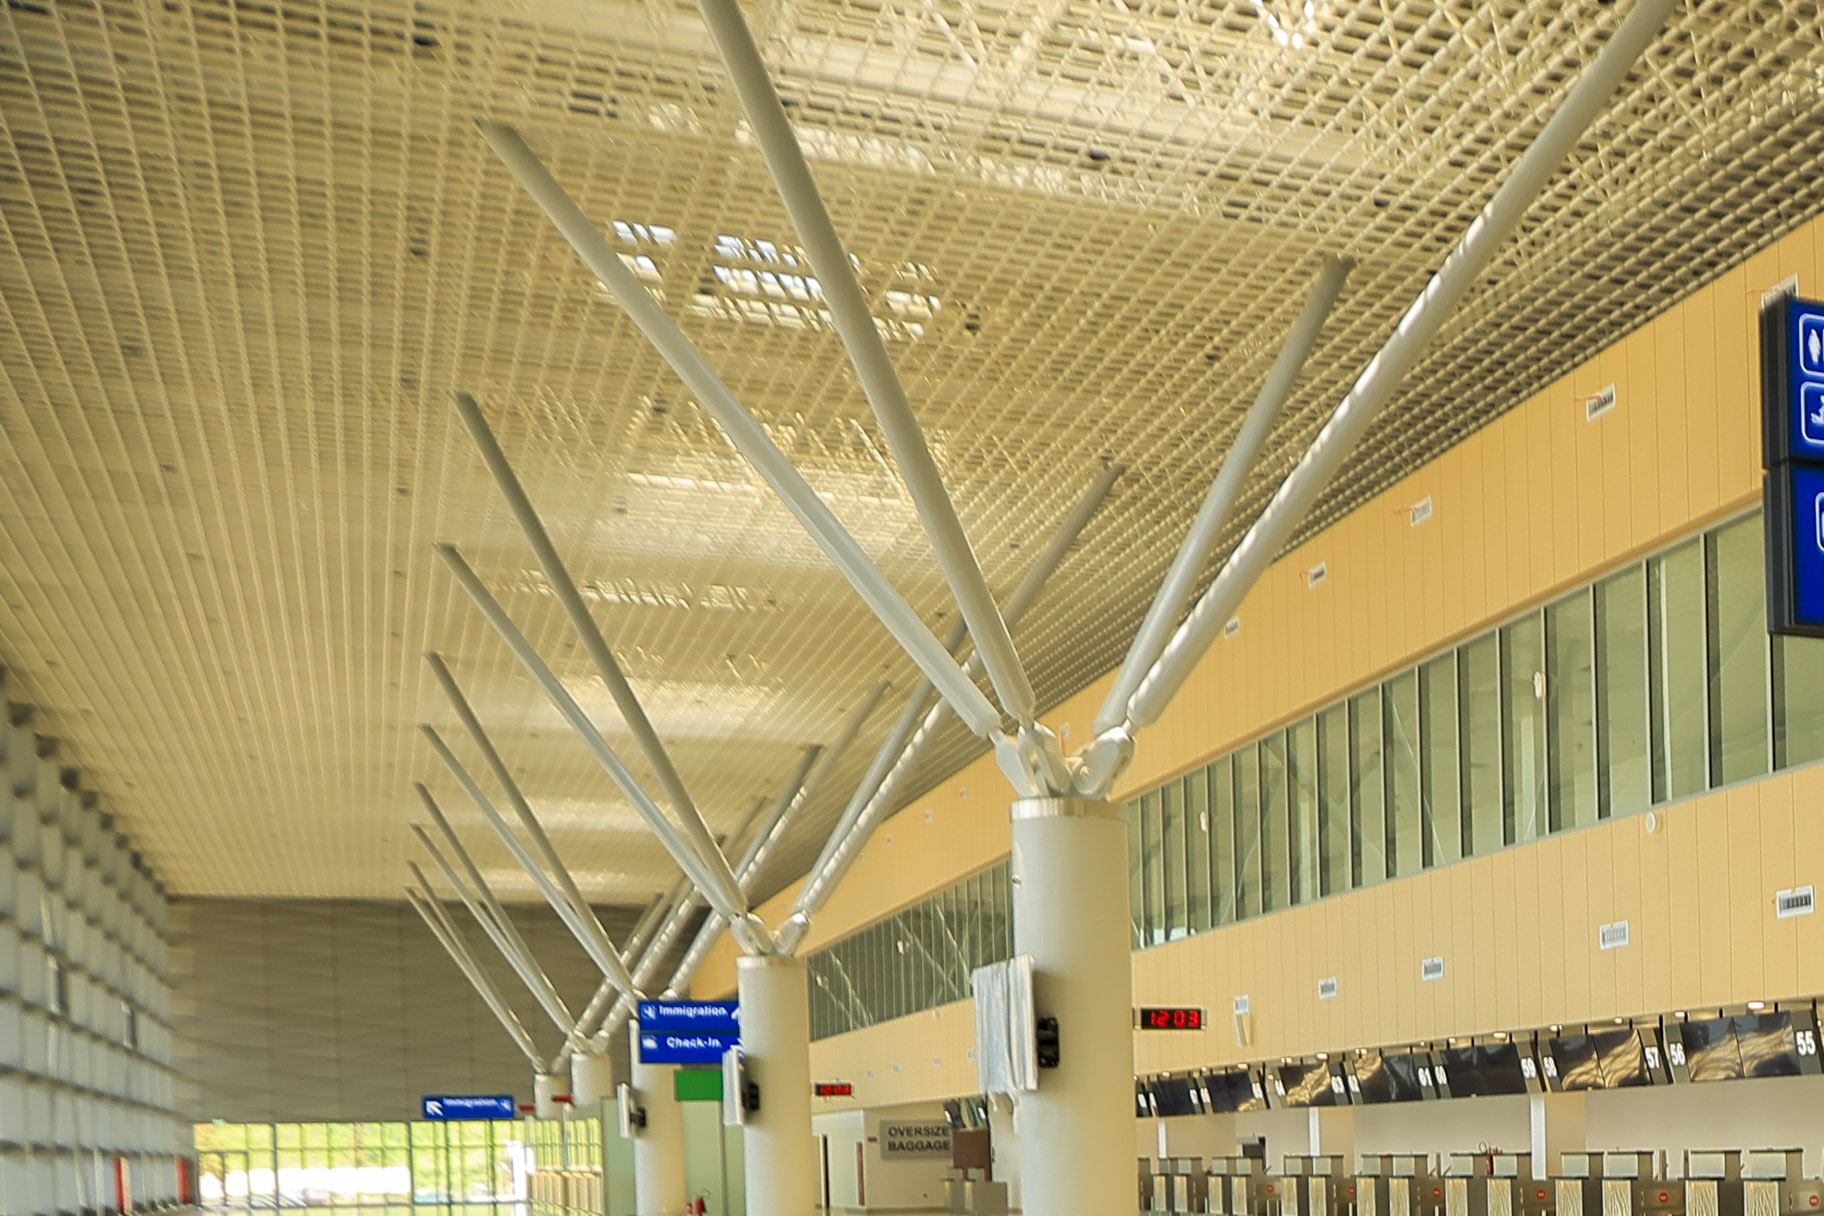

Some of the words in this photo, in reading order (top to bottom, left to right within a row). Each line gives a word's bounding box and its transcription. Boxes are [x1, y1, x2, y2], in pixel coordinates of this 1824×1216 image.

[1668, 1041, 1687, 1067] 56
[1795, 1029, 1817, 1057] 55
[1520, 1056, 1537, 1080] 59
[1643, 1046, 1661, 1070] 57
[1417, 1066, 1433, 1088] 61
[888, 1126, 950, 1138] OVERSIZE
[887, 1140, 951, 1152] BAGGAGE
